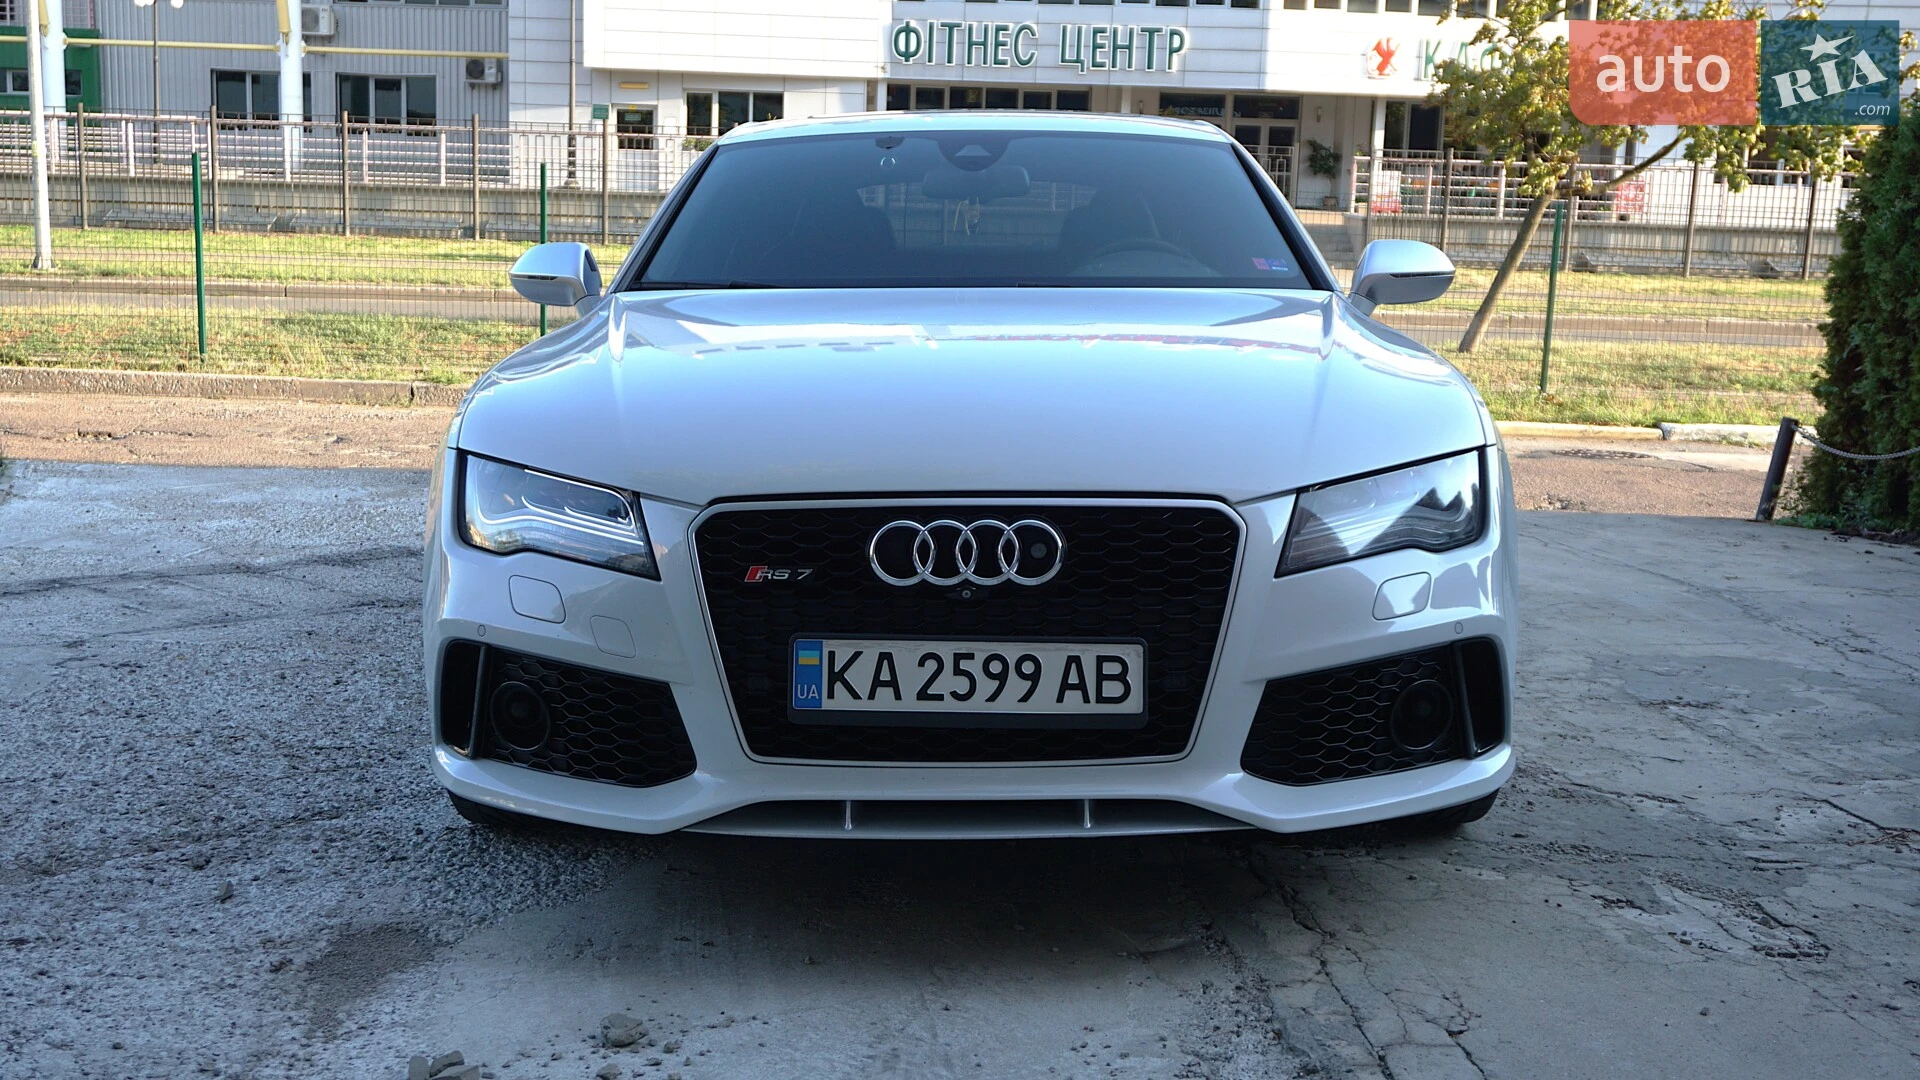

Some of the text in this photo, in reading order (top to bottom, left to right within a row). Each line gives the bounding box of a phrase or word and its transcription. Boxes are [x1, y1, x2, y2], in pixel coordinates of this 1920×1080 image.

[892, 20, 1188, 74] ФІТНЕС ЦЕНТР
[752, 568, 813, 580] RS 7
[797, 685, 819, 700] UA
[827, 651, 1132, 704] KA 2599 AB
